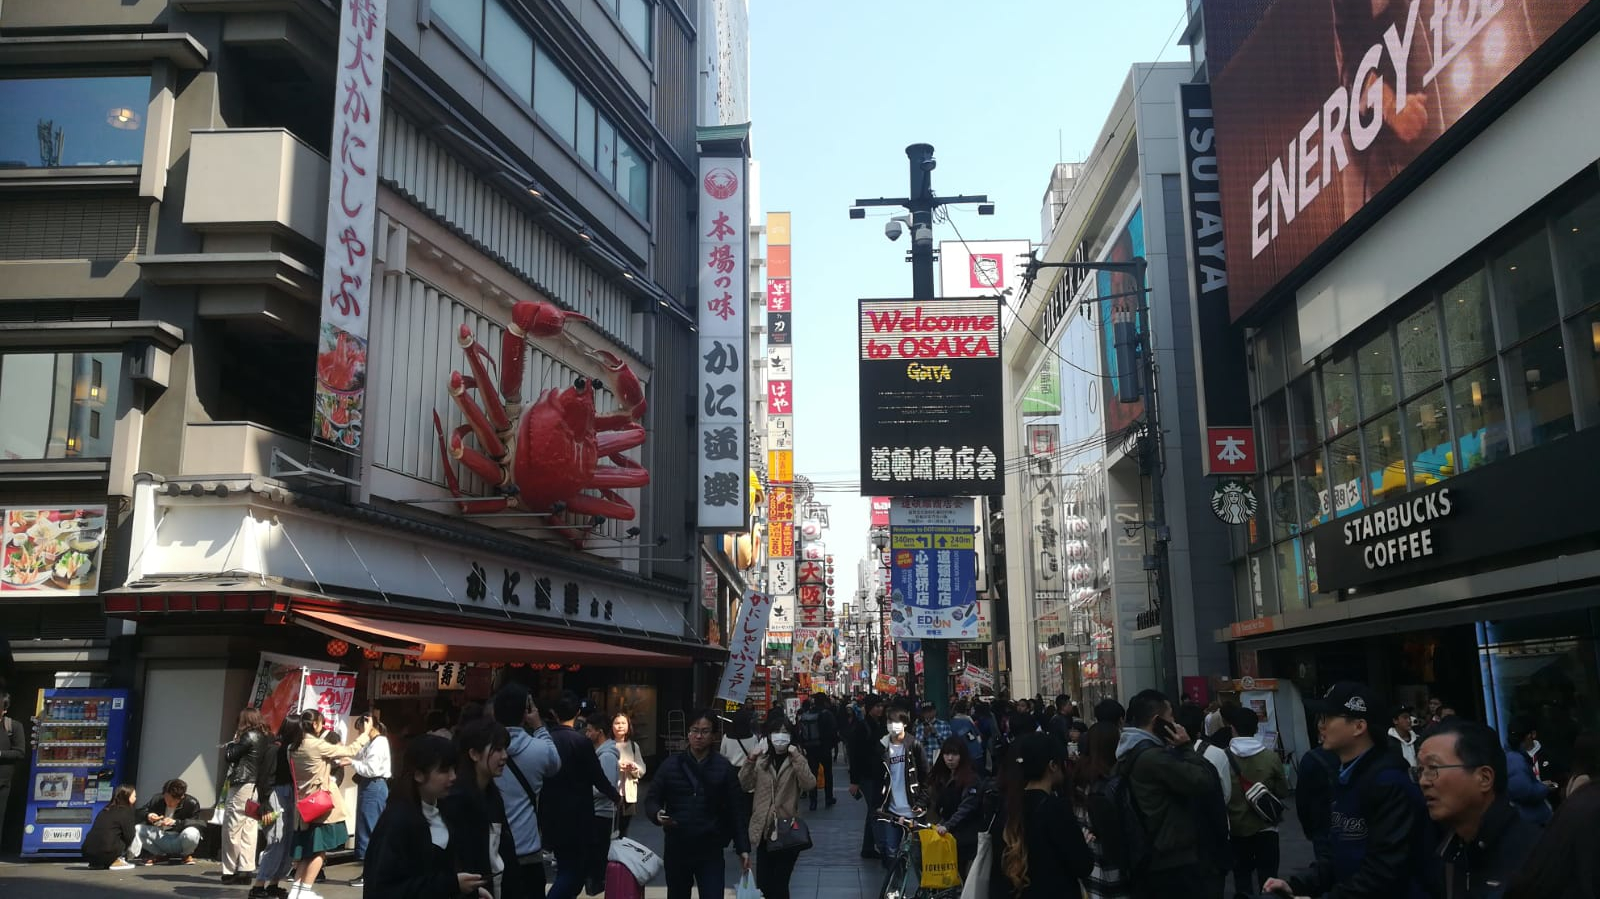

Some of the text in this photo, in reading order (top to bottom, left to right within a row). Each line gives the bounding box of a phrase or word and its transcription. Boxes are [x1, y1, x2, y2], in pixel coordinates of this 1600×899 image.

[1251, 0, 1418, 260] ENERGY
[705, 210, 737, 321] 本場の味
[865, 306, 995, 333] Welcome
[865, 336, 998, 359] to OSAKA
[871, 445, 997, 482] 道頓堀商店会
[1215, 435, 1248, 465] 本
[1343, 488, 1452, 547] STARBUCKS
[1363, 528, 1434, 571] COFFEE
[917, 615, 952, 629] EDION
